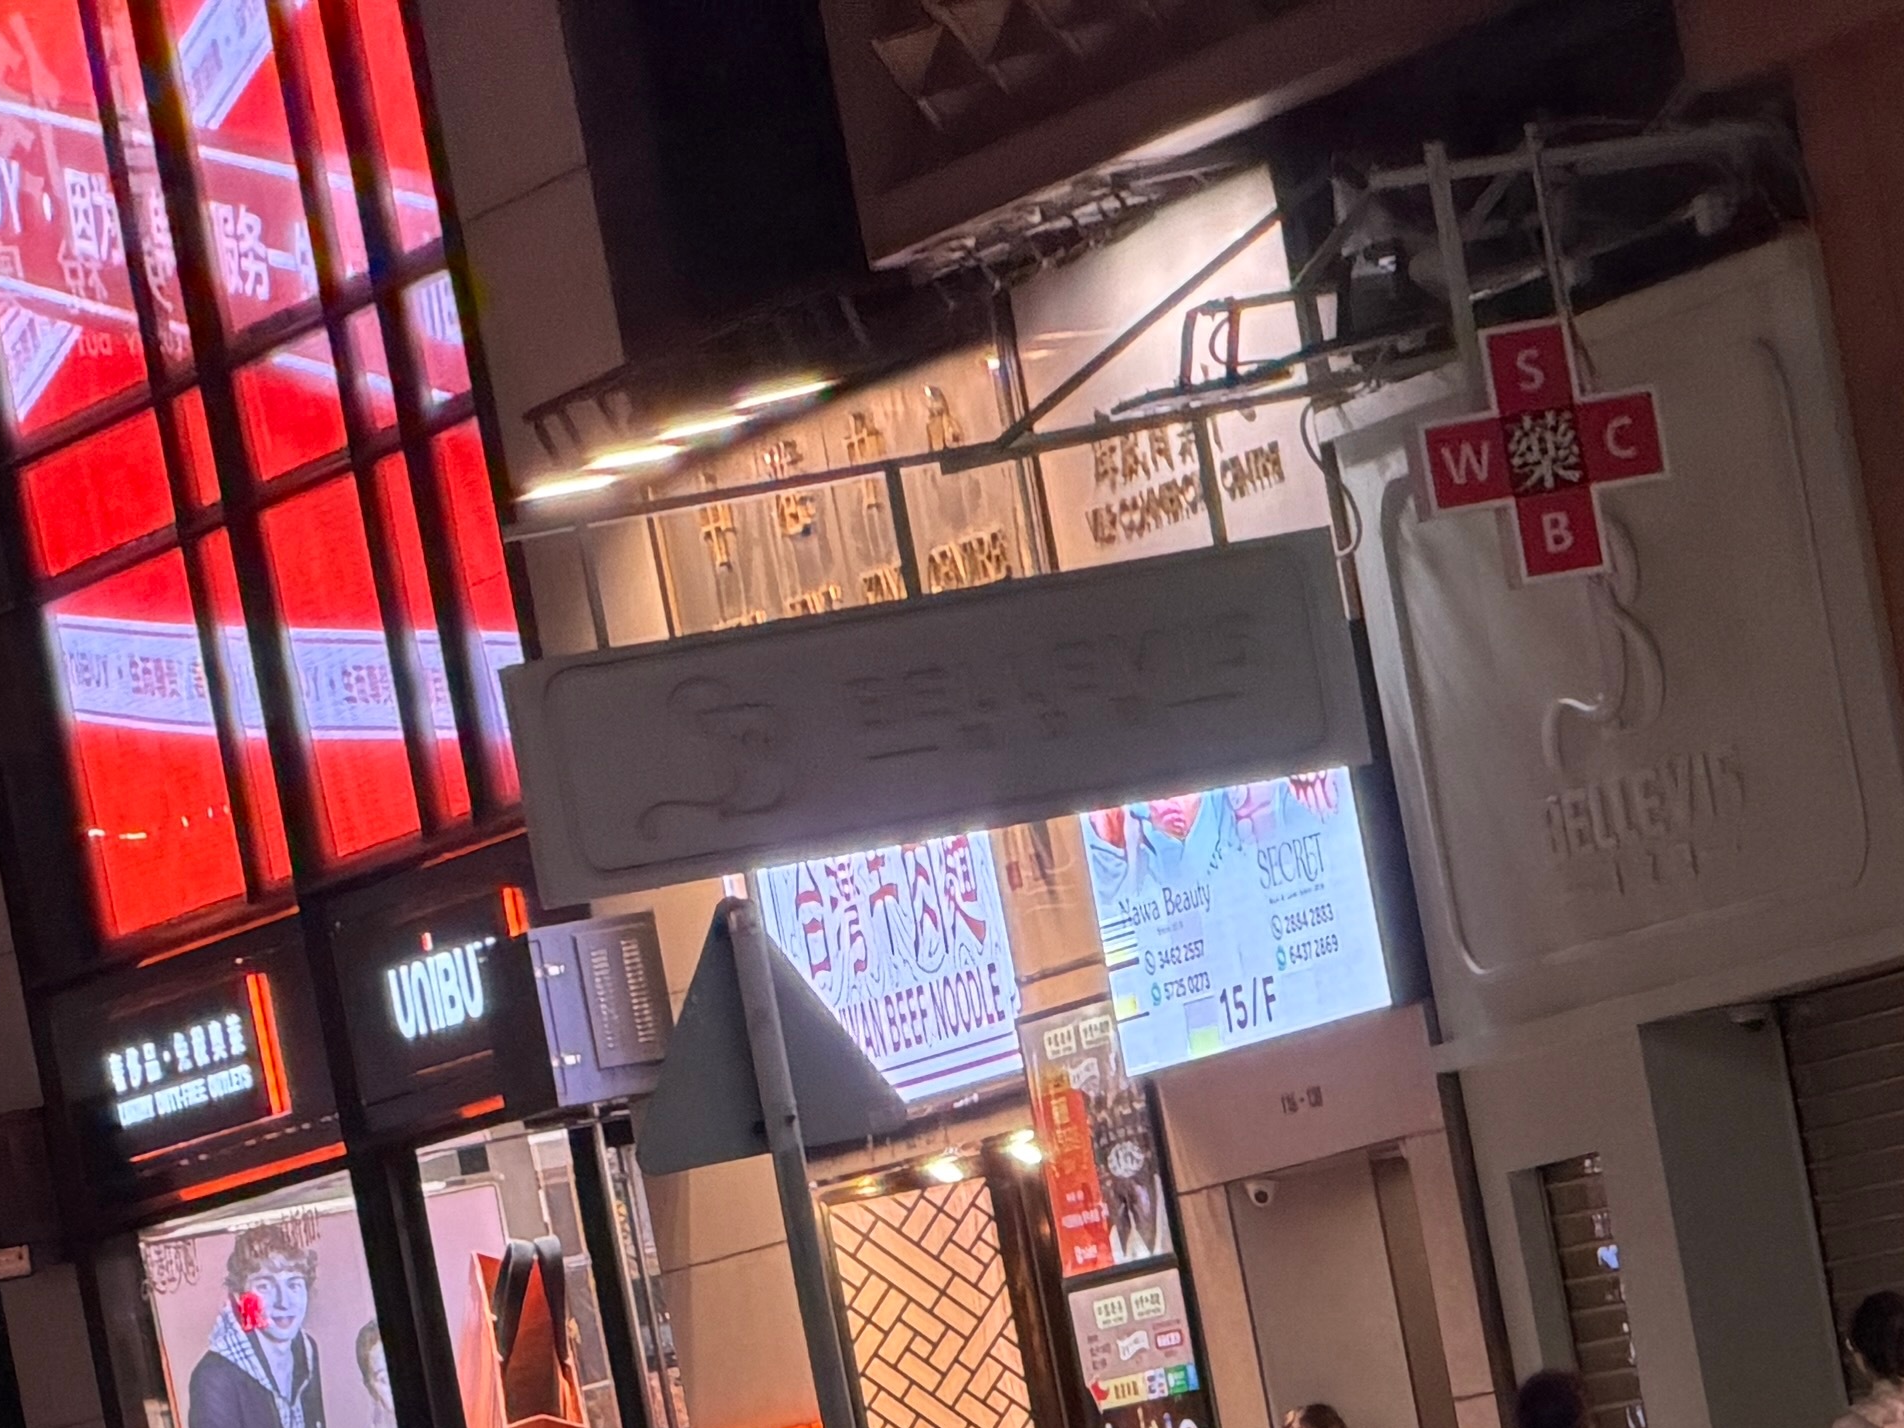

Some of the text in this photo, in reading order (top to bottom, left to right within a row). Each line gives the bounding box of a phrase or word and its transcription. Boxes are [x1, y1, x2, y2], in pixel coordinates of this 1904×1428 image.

[1516, 349, 1546, 392] S
[1605, 415, 1637, 460] C
[1440, 438, 1490, 486] W
[1541, 511, 1575, 554] B
[1256, 831, 1326, 891] SECRET
[1162, 882, 1212, 914] Beauty
[884, 983, 929, 1053] BEEF
[928, 962, 1007, 1042] NOODLE
[1219, 974, 1277, 1034] 15/F
